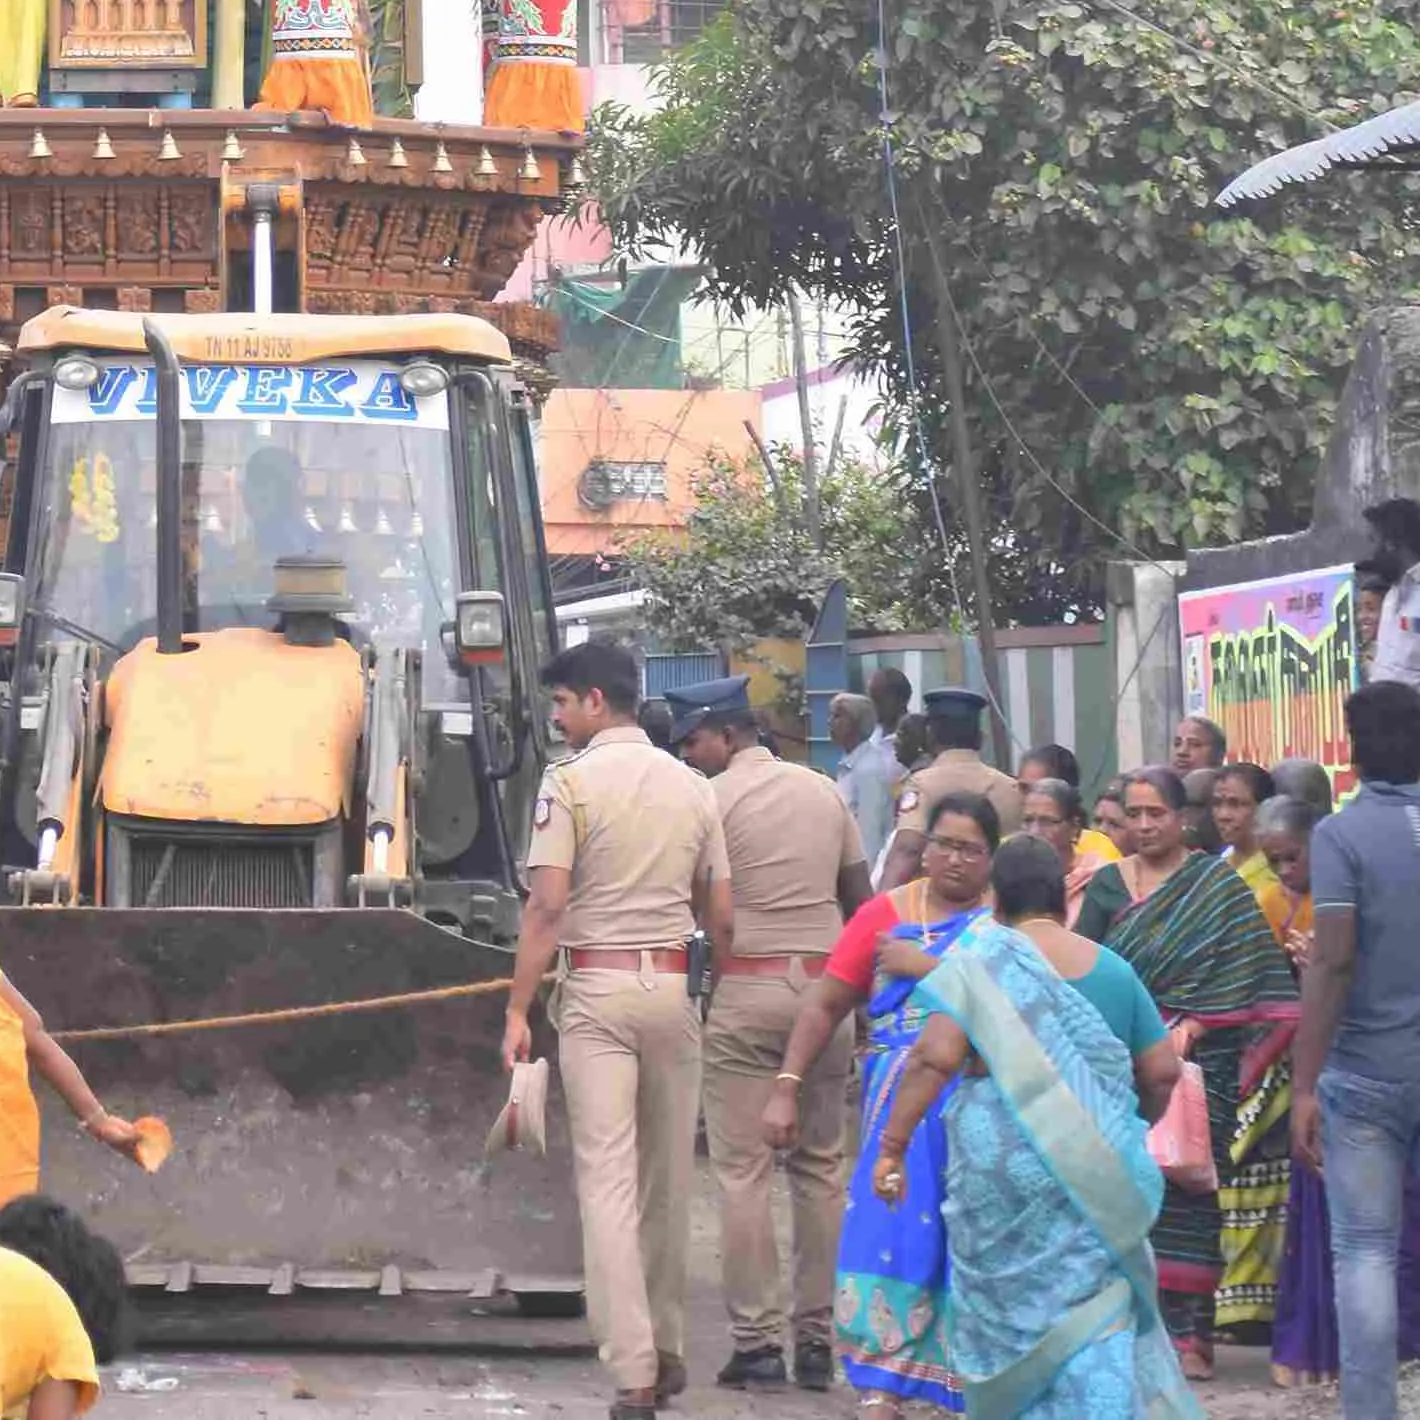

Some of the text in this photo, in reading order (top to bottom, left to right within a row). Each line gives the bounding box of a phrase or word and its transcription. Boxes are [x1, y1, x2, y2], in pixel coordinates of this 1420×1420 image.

[205, 337, 221, 357] TN
[226, 339, 238, 357] 11
[244, 336, 259, 358] AJ
